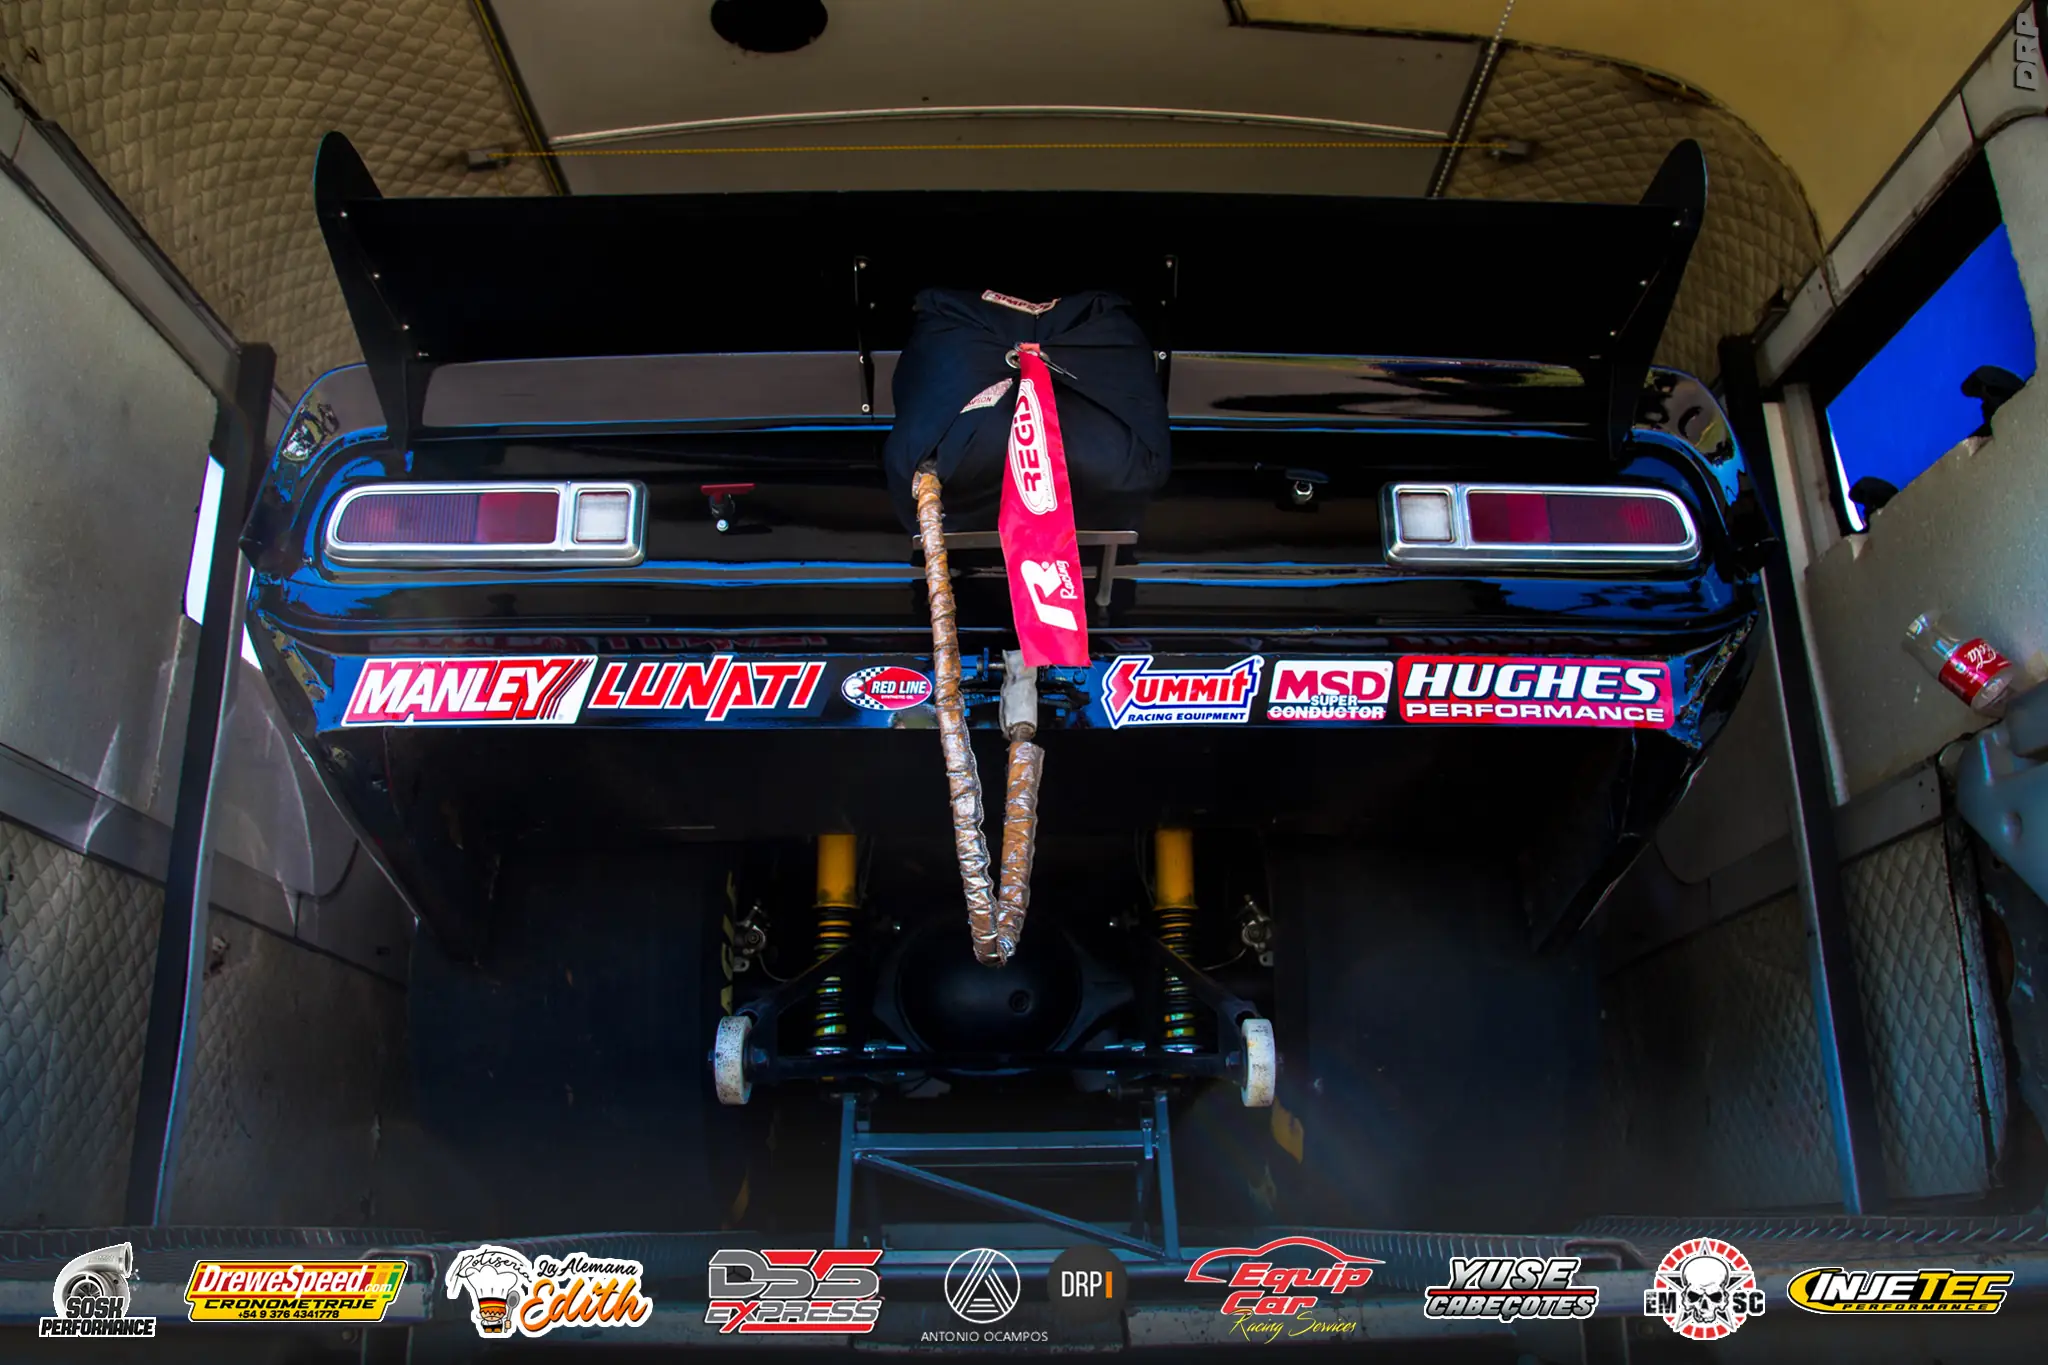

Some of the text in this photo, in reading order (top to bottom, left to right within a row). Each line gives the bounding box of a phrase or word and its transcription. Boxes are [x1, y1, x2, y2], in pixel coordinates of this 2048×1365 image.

[1059, 559, 1078, 600] Racing
[353, 666, 562, 714] MANLEY
[588, 655, 826, 722] LUNATI
[871, 681, 927, 694] RED LINE
[1275, 669, 1387, 700] MSD
[1405, 662, 1663, 701] HUGHES
[1269, 706, 1385, 719] CONDUCTOR
[1310, 695, 1358, 706] SUPER
[1406, 703, 1665, 722] PERFORMANCE
[1127, 712, 1246, 722] RACING EQUIPMENT
